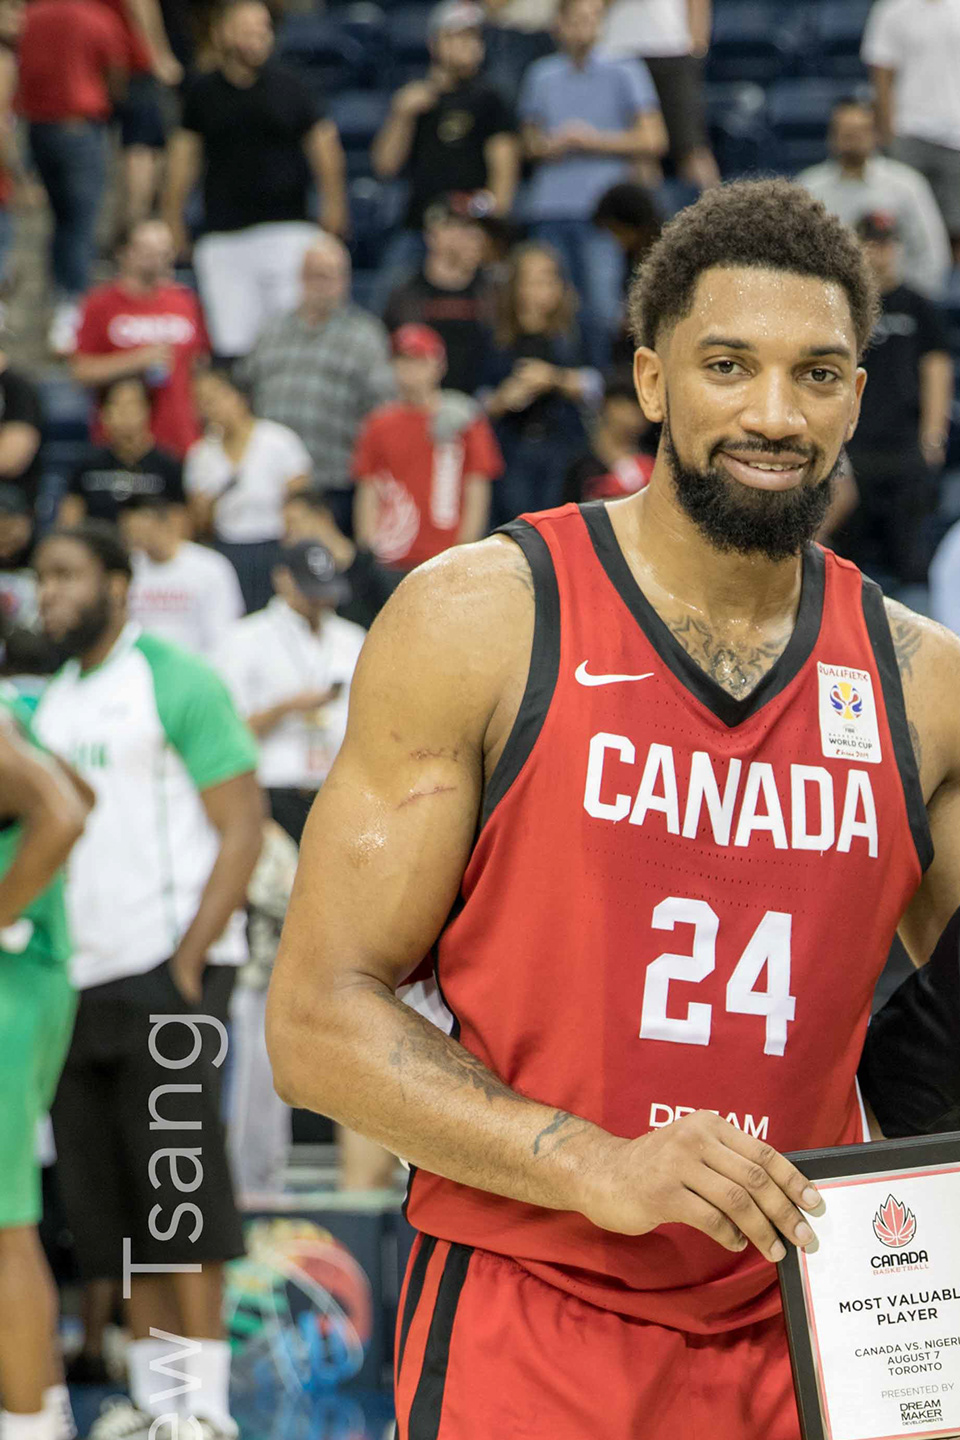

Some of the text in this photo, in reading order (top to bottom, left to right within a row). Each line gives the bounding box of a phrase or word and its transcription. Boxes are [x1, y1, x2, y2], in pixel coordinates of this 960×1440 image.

[828, 738, 873, 750] WORLD CUP
[583, 732, 878, 858] CANADA
[639, 896, 796, 1056] 24
[649, 1102, 769, 1140] DRAM
[870, 1249, 929, 1268] CANADA
[873, 1264, 929, 1275] BASKETBALL
[839, 1297, 882, 1313] MOST
[877, 1307, 938, 1326] PLAYER
[854, 1344, 902, 1358] CANADA
[904, 1341, 922, 1351] VS.
[887, 1350, 940, 1365] AUGUST 7
[888, 1362, 943, 1376] TORONTO
[881, 1382, 955, 1398] PRESENTED BY
[900, 1399, 941, 1412] DREAM
[901, 1408, 942, 1421] MAKER
[902, 1417, 944, 1426] DEVELOPMENTS
